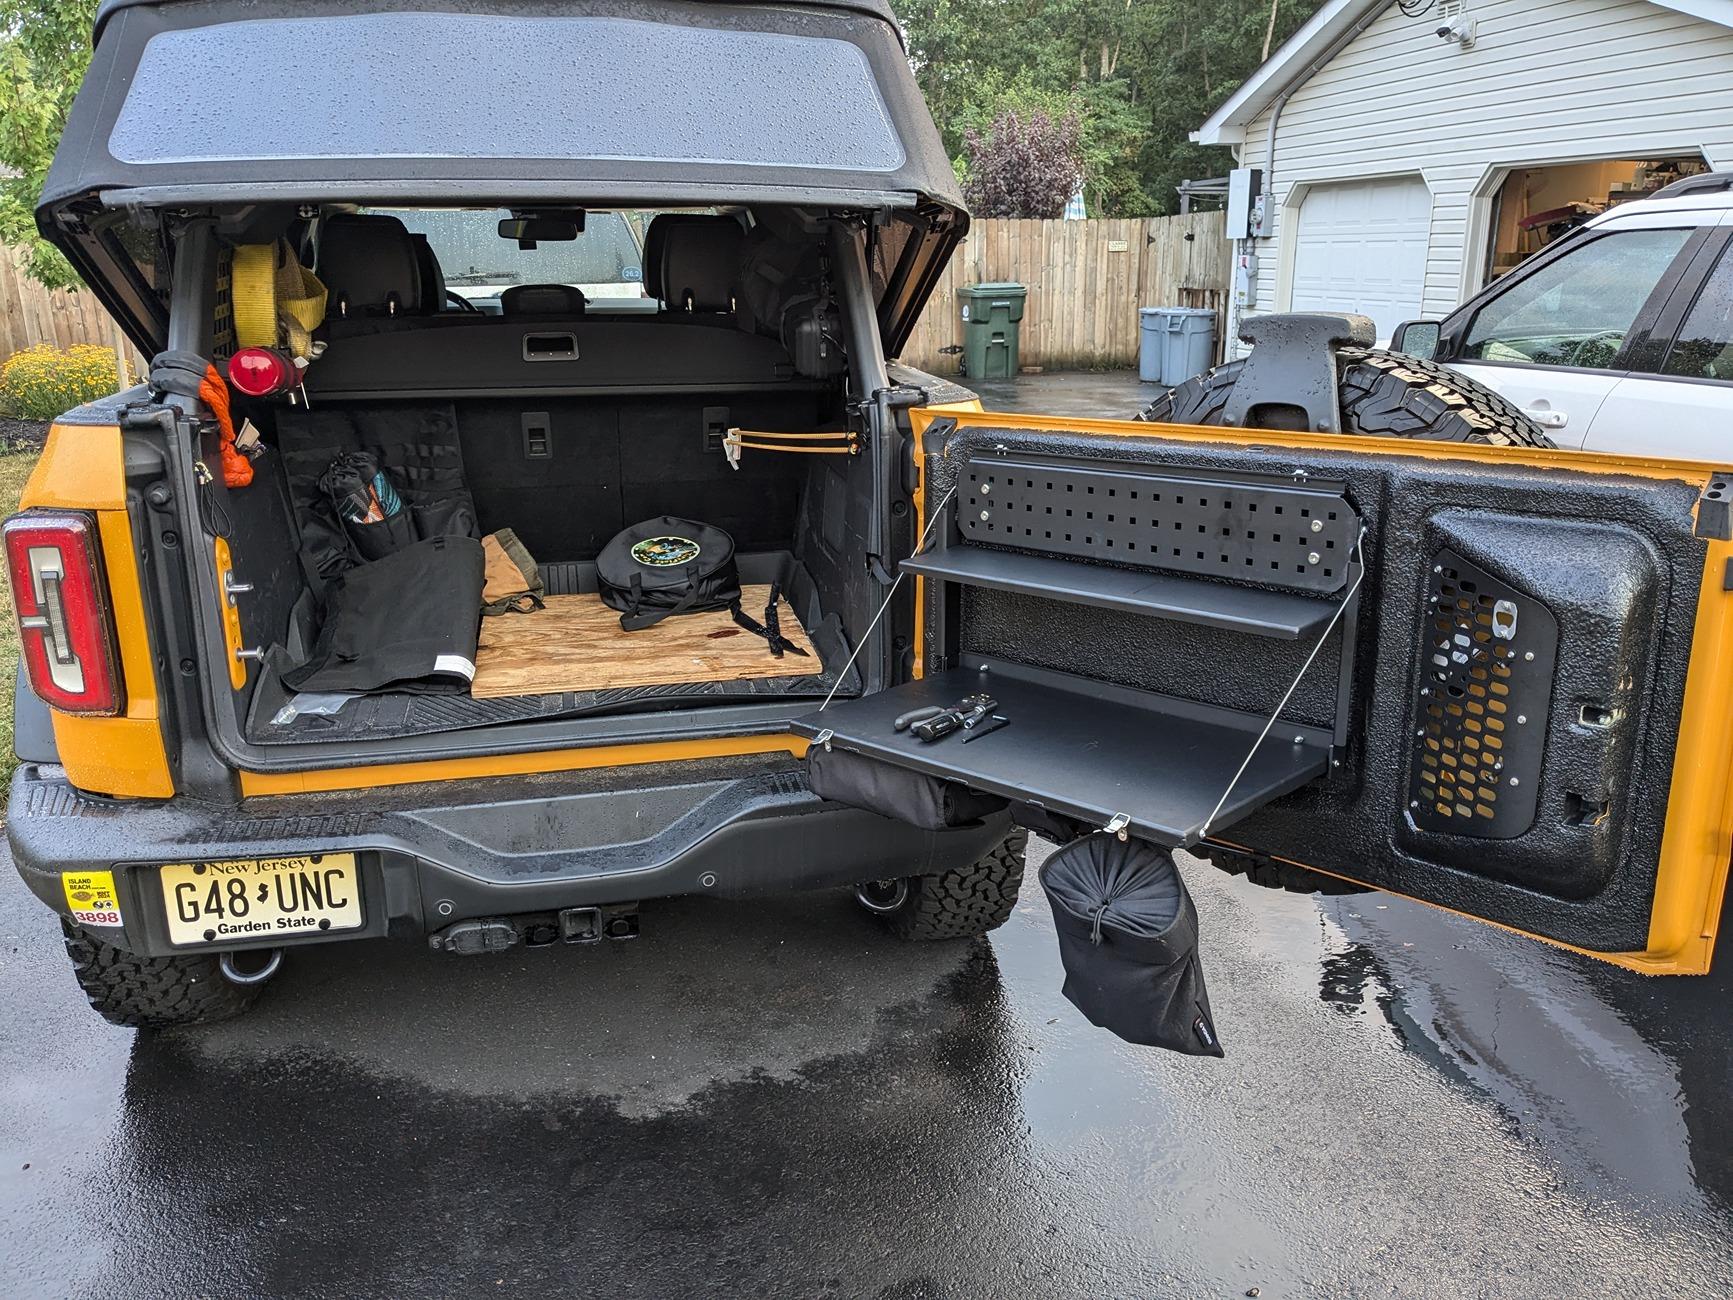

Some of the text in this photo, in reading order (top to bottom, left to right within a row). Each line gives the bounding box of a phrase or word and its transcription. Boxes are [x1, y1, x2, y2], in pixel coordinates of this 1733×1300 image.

[209, 858, 308, 876] New Jersey
[175, 869, 348, 923] G48 UNC
[75, 912, 119, 923] 3898
[217, 916, 316, 935] Garden State
